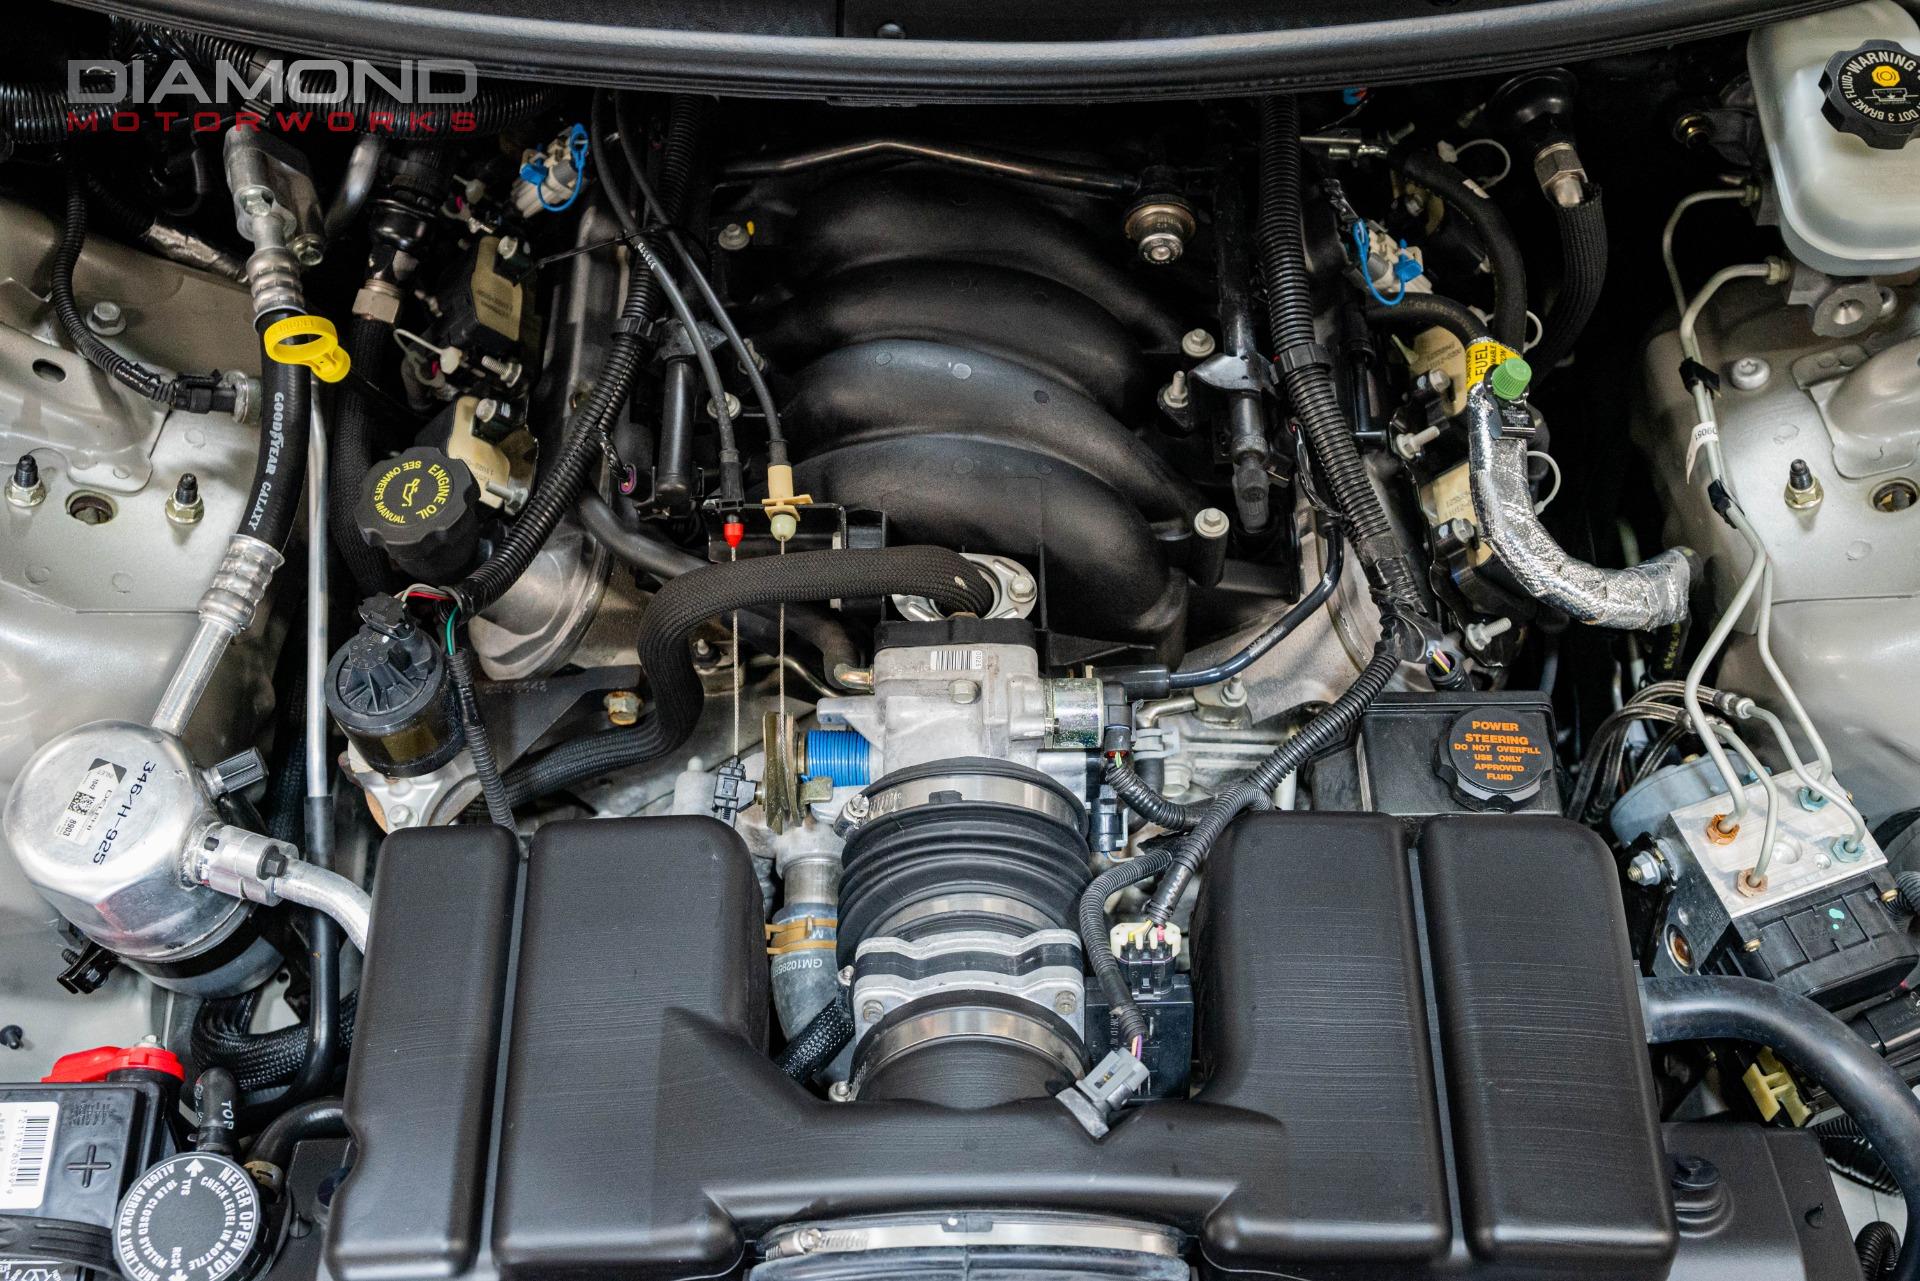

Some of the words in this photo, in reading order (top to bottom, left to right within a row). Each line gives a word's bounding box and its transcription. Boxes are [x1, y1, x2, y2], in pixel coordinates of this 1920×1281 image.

[1846, 51, 1917, 74] WARNING
[1842, 74, 1857, 99] FLUID
[1851, 99, 1885, 120] BRAKE
[1887, 112, 1895, 122] 3
[1898, 109, 1920, 122] DOT
[1475, 345, 1488, 376] FUEL
[265, 391, 285, 476] GOODYEAR
[402, 460, 422, 472] SEE
[427, 463, 451, 505] ENGINE
[248, 481, 272, 531] GALAXY
[375, 502, 406, 524] MANUAL
[415, 504, 437, 520] OIL
[1471, 720, 1519, 732] POWER
[1453, 743, 1468, 751] DO
[1472, 744, 1491, 752] NOT
[1496, 745, 1542, 755] OVERFILL
[1464, 732, 1529, 746] STEERING
[1474, 753, 1493, 761] USE
[1498, 754, 1522, 763] ONLY
[1474, 763, 1525, 772] APPROVED
[1486, 772, 1514, 781] FLUID
[221, 1100, 234, 1130] TOP
[143, 1163, 175, 1190] ALIGN
[200, 1176, 229, 1200] CHECK
[218, 1166, 251, 1208] NEVER
[122, 1187, 147, 1228] ARROW
[138, 1200, 158, 1236] CLOSED
[223, 1198, 237, 1228] LEVEL
[120, 1228, 132, 1238] &
[219, 1230, 233, 1242] IN
[230, 1211, 253, 1251] OPEN
[121, 1237, 140, 1267] VENT
[139, 1236, 168, 1269] SYSTEM
[188, 1242, 226, 1271] BOTTLE
[134, 1261, 160, 1281] TUBE
[206, 1251, 237, 1279] HOT
